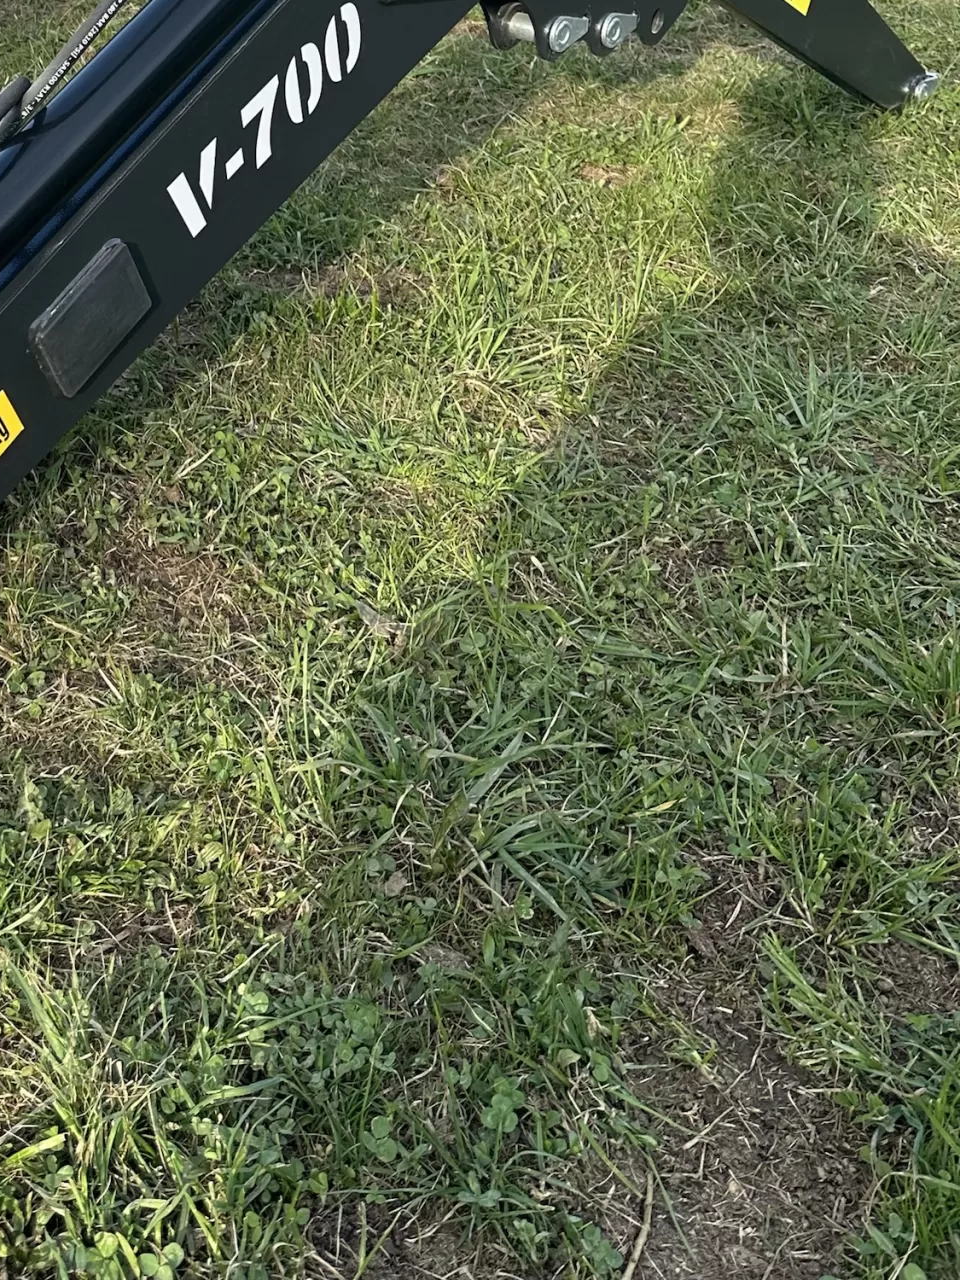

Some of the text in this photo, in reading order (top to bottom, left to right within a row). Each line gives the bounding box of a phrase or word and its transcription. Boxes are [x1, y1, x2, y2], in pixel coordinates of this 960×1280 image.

[97, 13, 109, 27] BAR
[49, 61, 70, 85] SAE100
[166, 1, 362, 239] V-700
